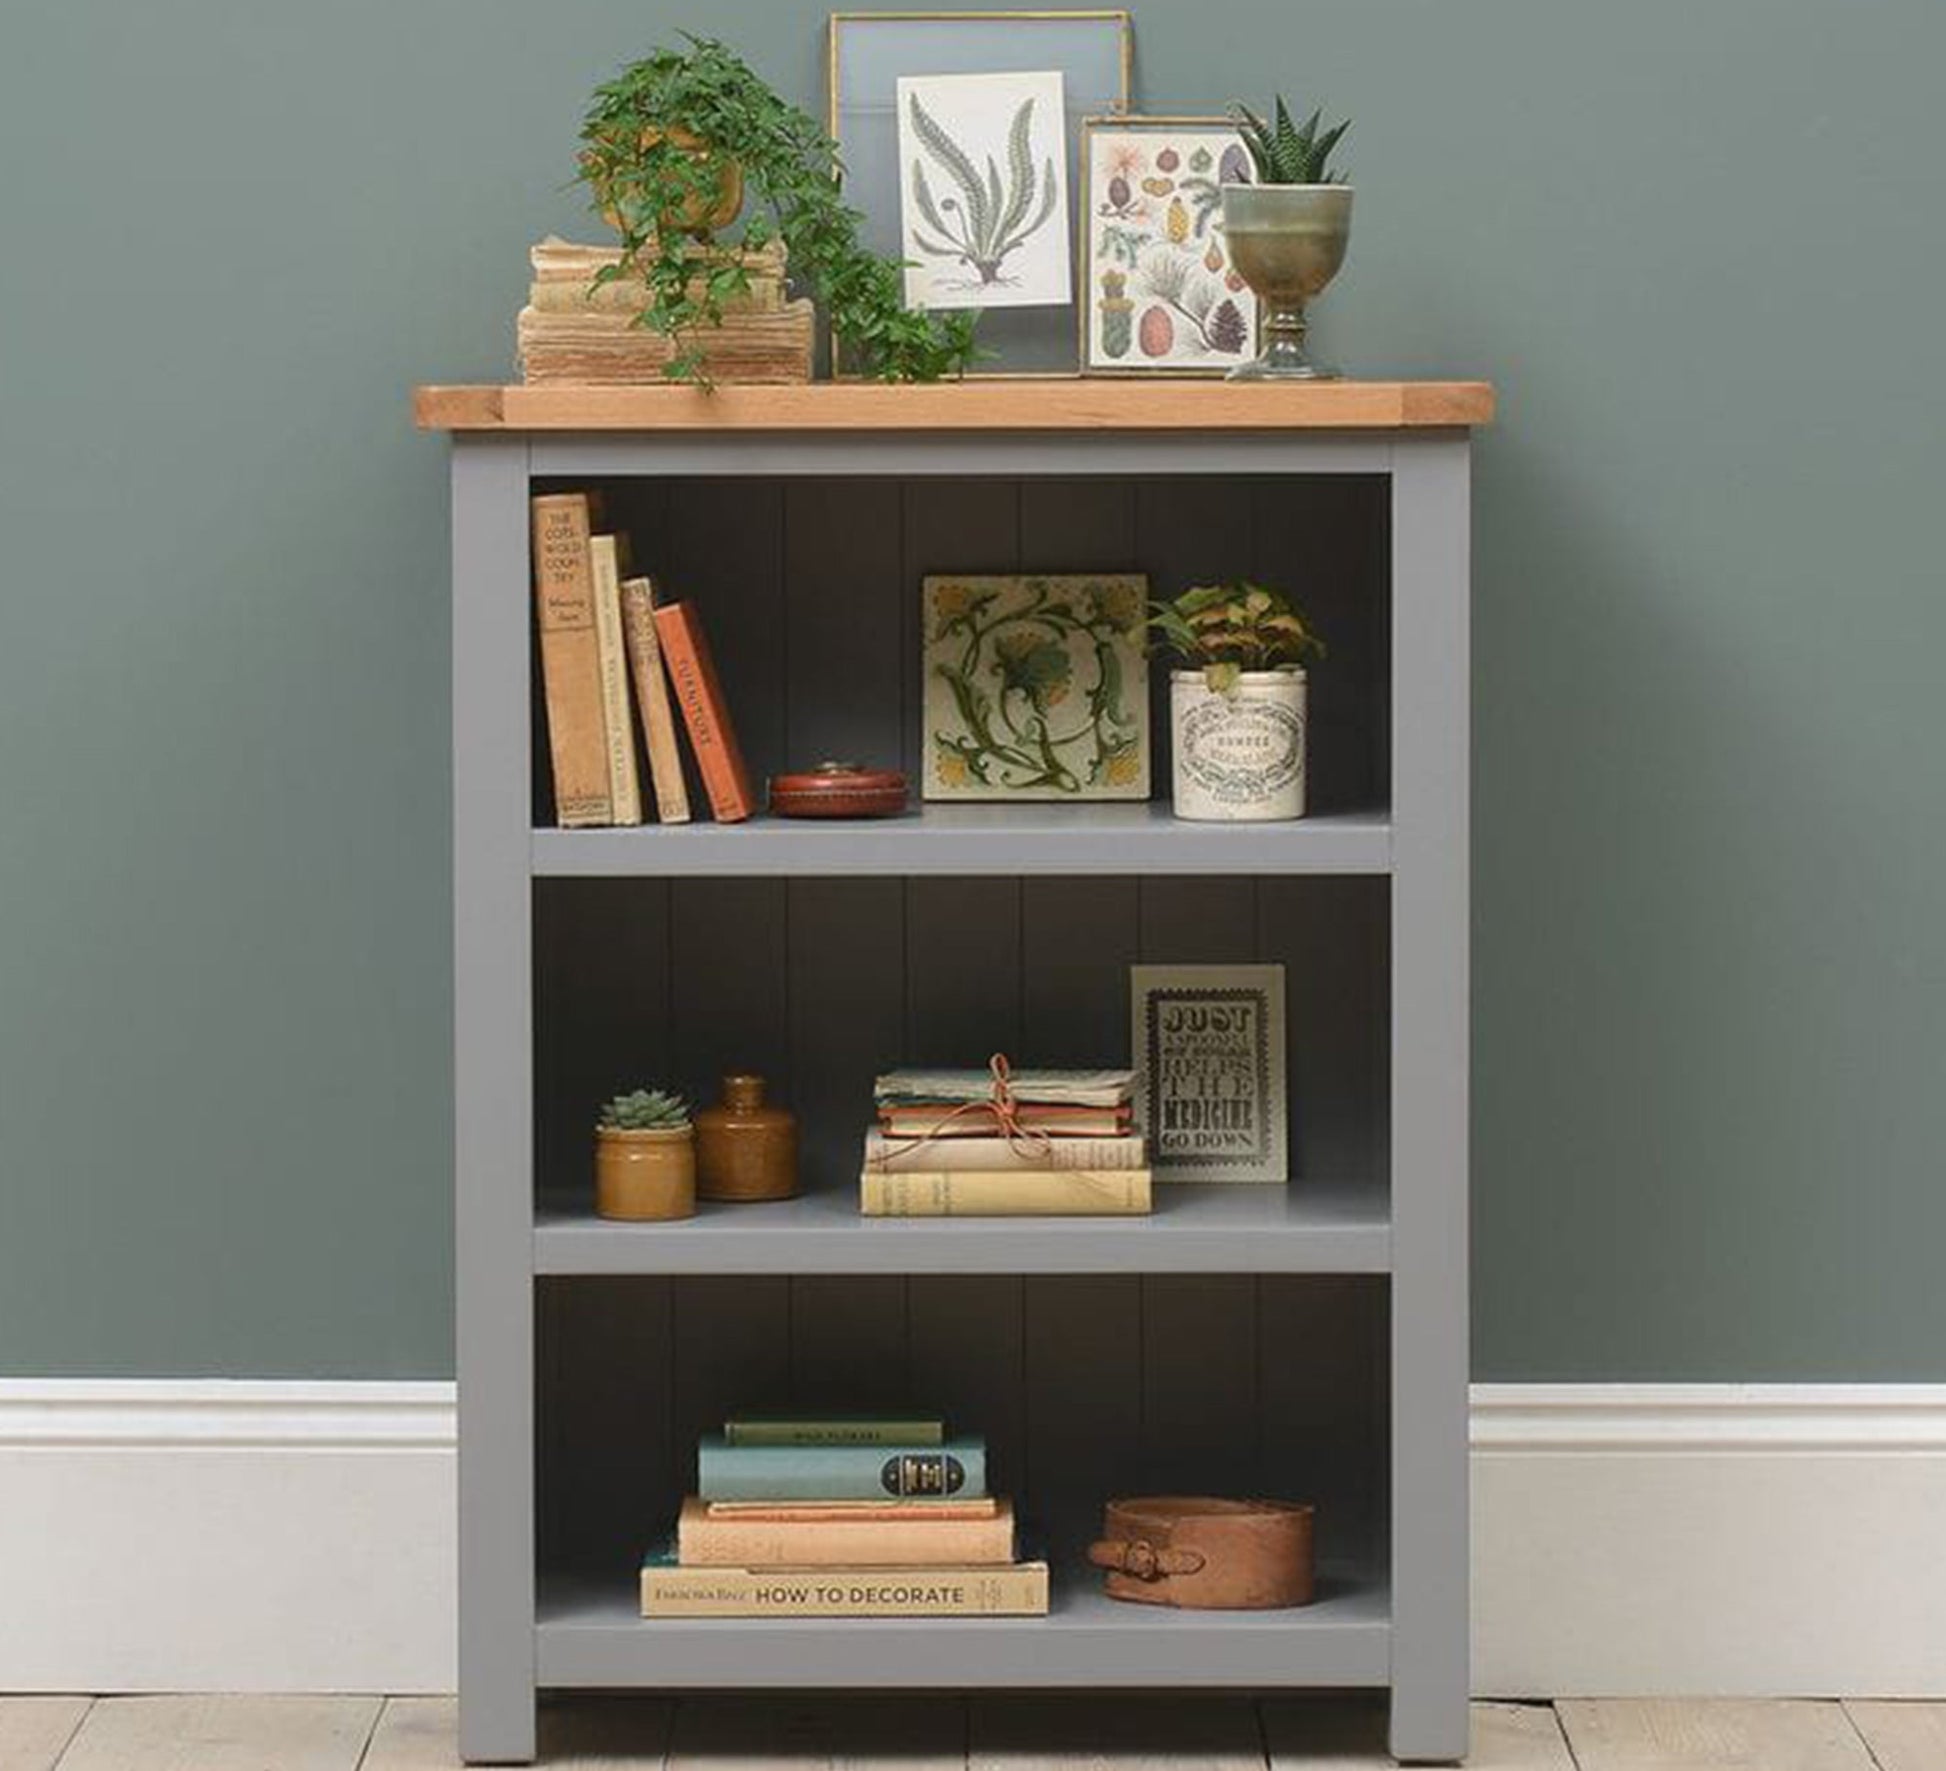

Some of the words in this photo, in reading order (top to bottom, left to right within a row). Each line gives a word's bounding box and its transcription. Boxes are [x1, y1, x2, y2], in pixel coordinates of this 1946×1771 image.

[678, 659, 711, 748] FURNITURE
[1163, 1006, 1252, 1033] JUST
[1164, 1059, 1252, 1076] HELPS
[1162, 1076, 1254, 1097] THE
[1164, 1098, 1252, 1131] MEDICINE
[1162, 1132, 1189, 1148] GO
[1196, 1132, 1253, 1148] DOWN
[756, 1586, 809, 1604] HOW
[816, 1586, 843, 1604] TO
[849, 1586, 964, 1604] DECORATE
